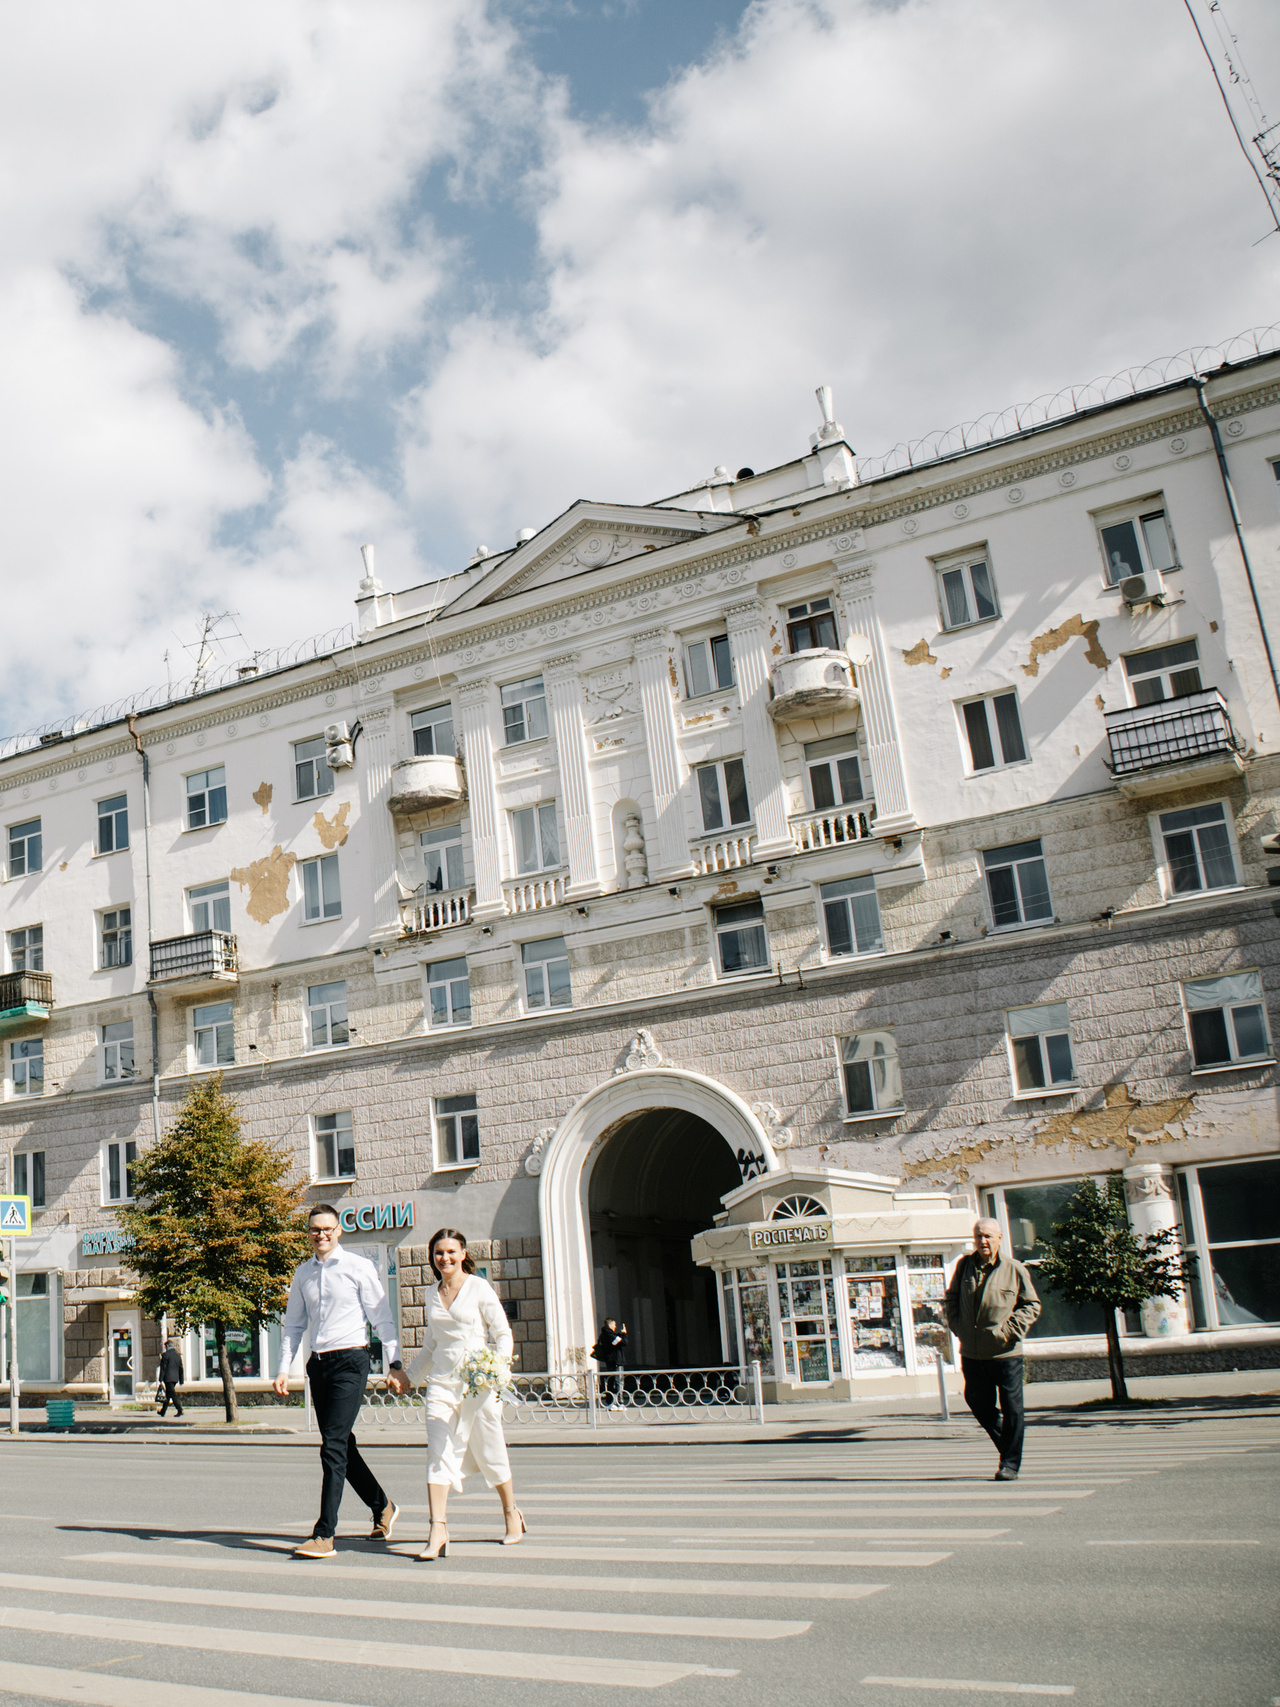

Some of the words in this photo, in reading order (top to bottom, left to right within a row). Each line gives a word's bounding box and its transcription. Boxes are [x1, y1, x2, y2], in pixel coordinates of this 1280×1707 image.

[338, 1200, 416, 1233] ССИИ
[82, 1230, 136, 1243] ФИРМЕ
[754, 1224, 828, 1246] РОСПЕЧАТЬ
